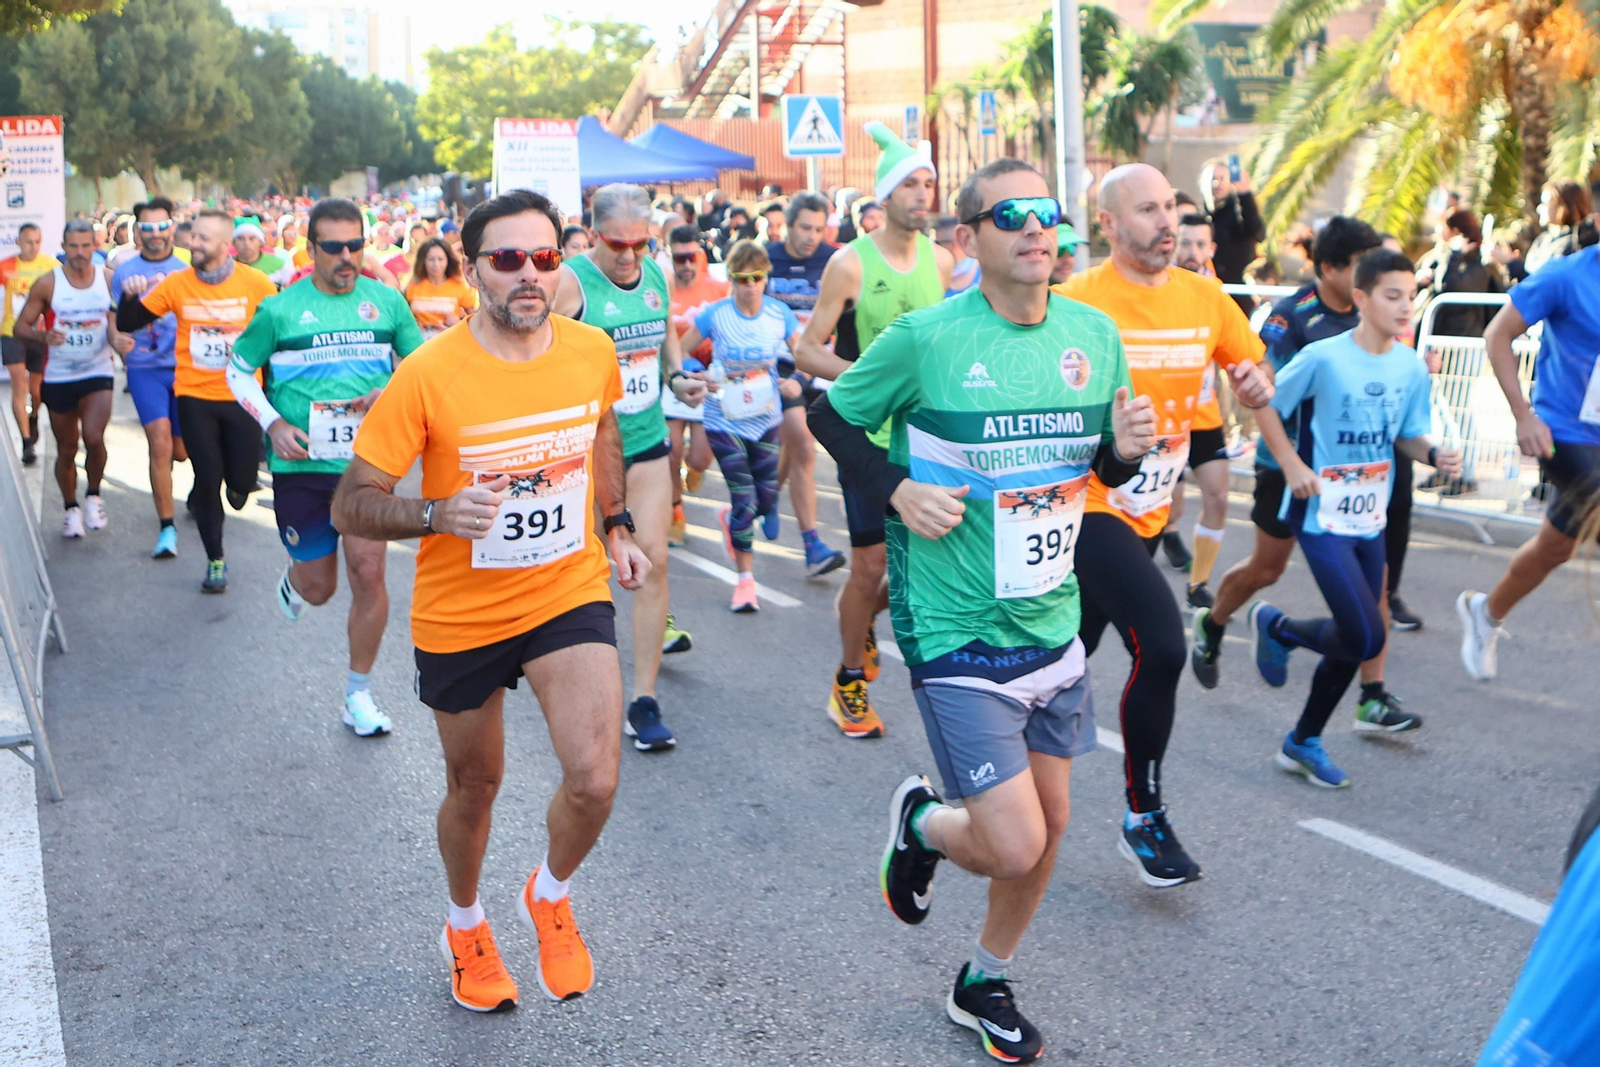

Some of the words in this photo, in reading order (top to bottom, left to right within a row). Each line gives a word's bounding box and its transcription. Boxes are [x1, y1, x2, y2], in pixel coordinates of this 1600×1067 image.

[2, 118, 58, 135] LIDA
[502, 121, 574, 135] SALIDA
[66, 333, 93, 347] 439
[312, 330, 375, 347] ATLETISMO
[613, 319, 666, 341] ATLETISMO
[302, 346, 384, 363] TORREMOLINOS
[622, 374, 649, 396] 46
[327, 425, 360, 444] 13
[983, 411, 1085, 439] ATLETISMO
[503, 451, 545, 469] PALMA
[962, 442, 1098, 473] TORREMOLINOS
[1131, 467, 1175, 495] 214
[1337, 492, 1377, 515] 400
[503, 503, 566, 541] 391
[1026, 523, 1074, 566] 392
